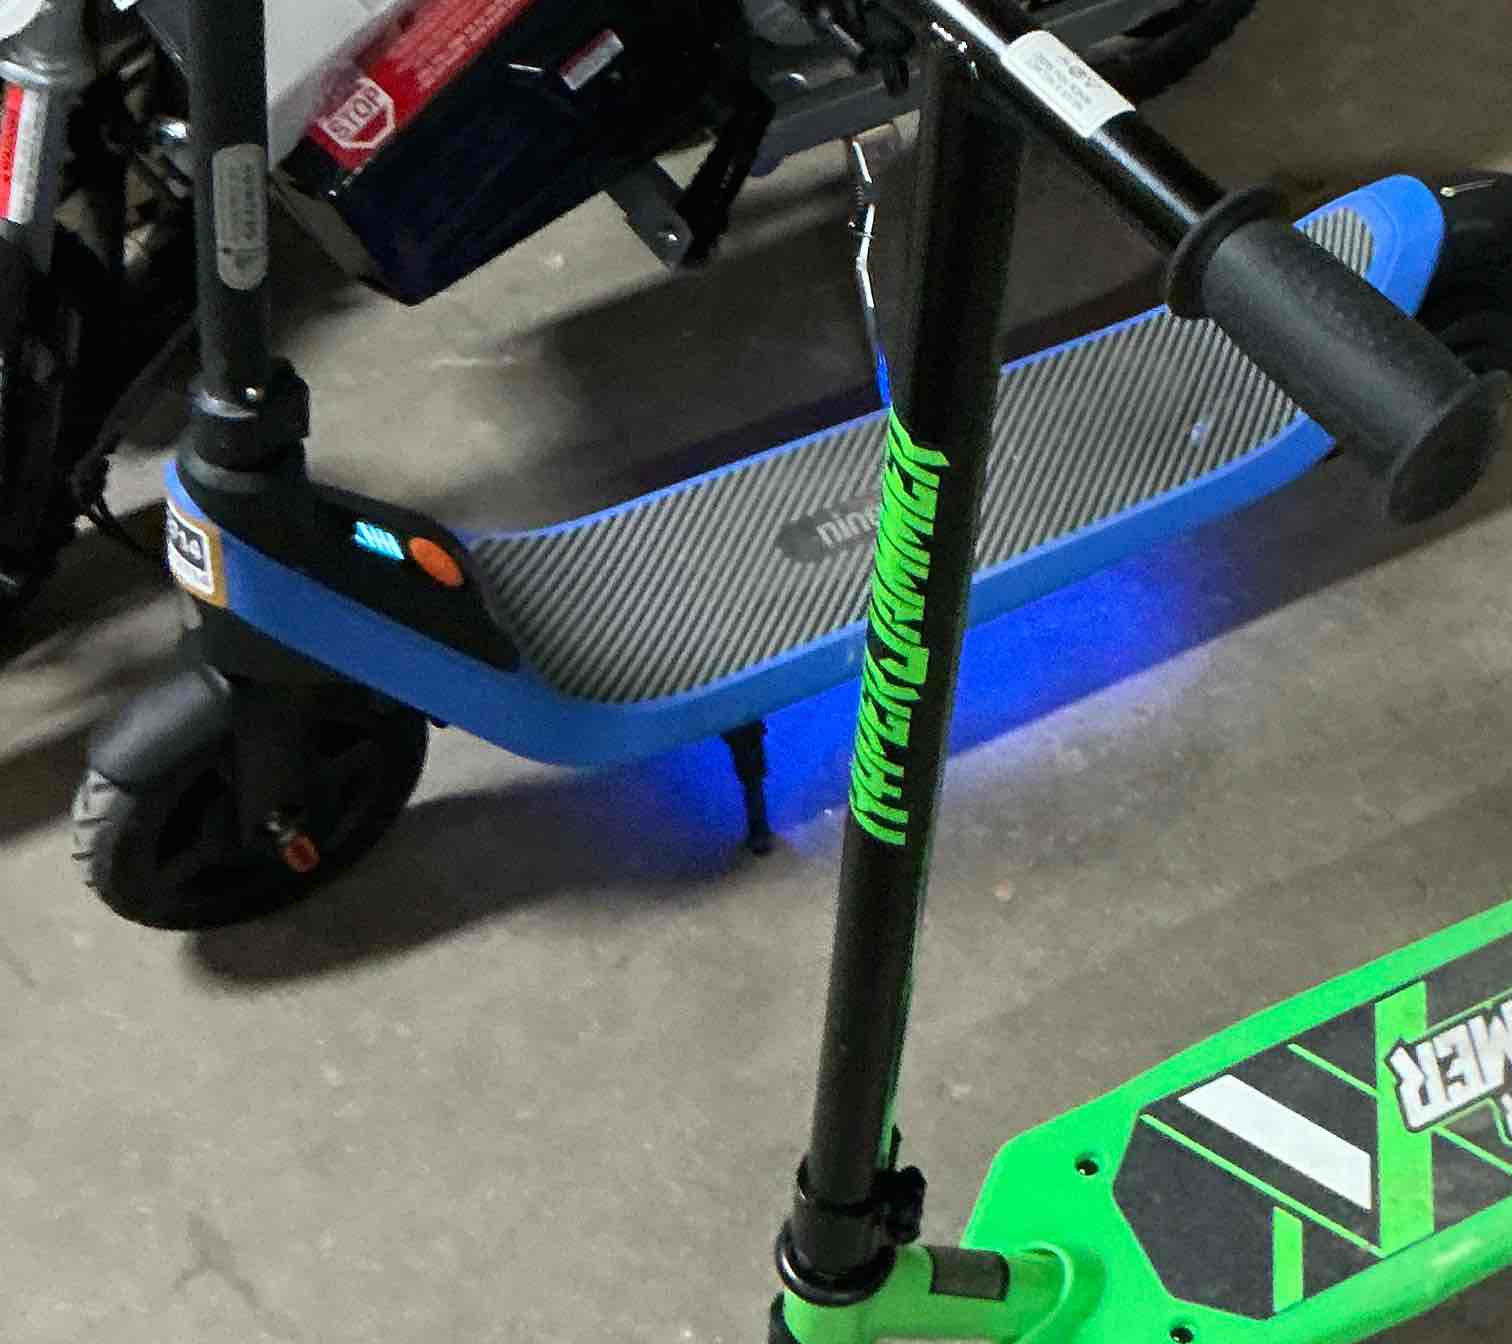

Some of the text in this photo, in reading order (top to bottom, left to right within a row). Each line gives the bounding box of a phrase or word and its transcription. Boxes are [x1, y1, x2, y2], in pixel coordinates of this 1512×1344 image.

[327, 84, 385, 140] STOP
[848, 406, 950, 847] HYPER JAMMER
